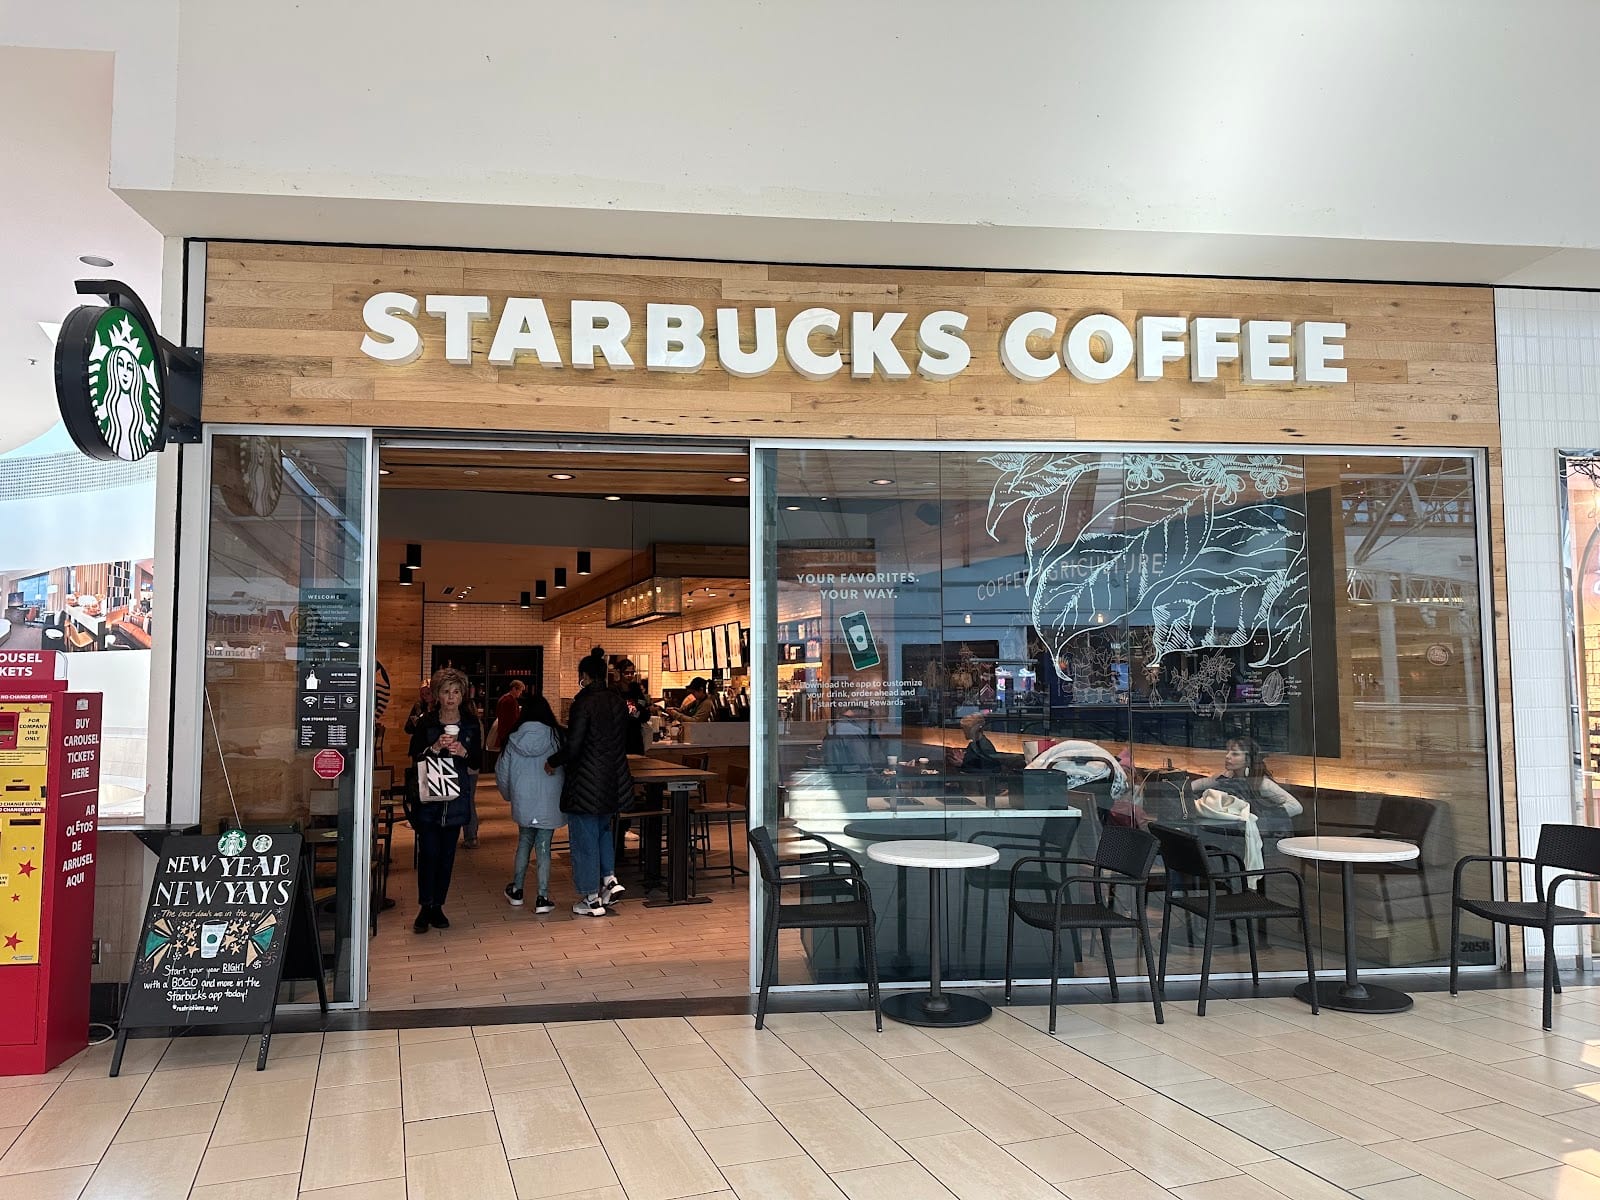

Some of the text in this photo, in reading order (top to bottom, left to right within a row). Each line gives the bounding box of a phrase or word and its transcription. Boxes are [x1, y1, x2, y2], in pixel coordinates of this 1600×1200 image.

[359, 292, 1348, 384] STARBUCKS COFFEE
[1037, 553, 1165, 584] GRICULTURE
[797, 572, 920, 584] YOUR FAVORITES.
[820, 588, 898, 600] YOUR WAY.
[0, 653, 43, 663] OUSEL
[0, 667, 33, 676] KETS
[855, 681, 872, 690] app
[882, 679, 923, 687] customize
[806, 691, 824, 699] your
[826, 690, 850, 698] drink,
[874, 689, 899, 697] ahead
[900, 688, 916, 696] and
[817, 699, 906, 709] start earning Rewards.
[75, 717, 90, 729] BUY
[63, 733, 100, 747] CAROUSEL
[67, 750, 95, 763] TICKETS
[71, 767, 90, 780] HERE
[85, 804, 96, 816] AR
[66, 820, 94, 837] OLETOS
[71, 840, 82, 853] DE
[62, 854, 94, 872] ARRUSEL
[165, 854, 290, 877] NEW YEAR
[66, 872, 85, 888] AQUI
[153, 880, 293, 907] NEW YAYS
[161, 909, 176, 917] The
[236, 908, 247, 917] the
[162, 963, 245, 978] Start your year RIGHT
[143, 980, 161, 989] with
[171, 977, 198, 988] BOGO
[201, 978, 215, 988] and
[217, 980, 234, 988] more
[236, 978, 244, 988] in
[245, 977, 261, 988] the
[166, 989, 249, 1003] Starbucks app today!
